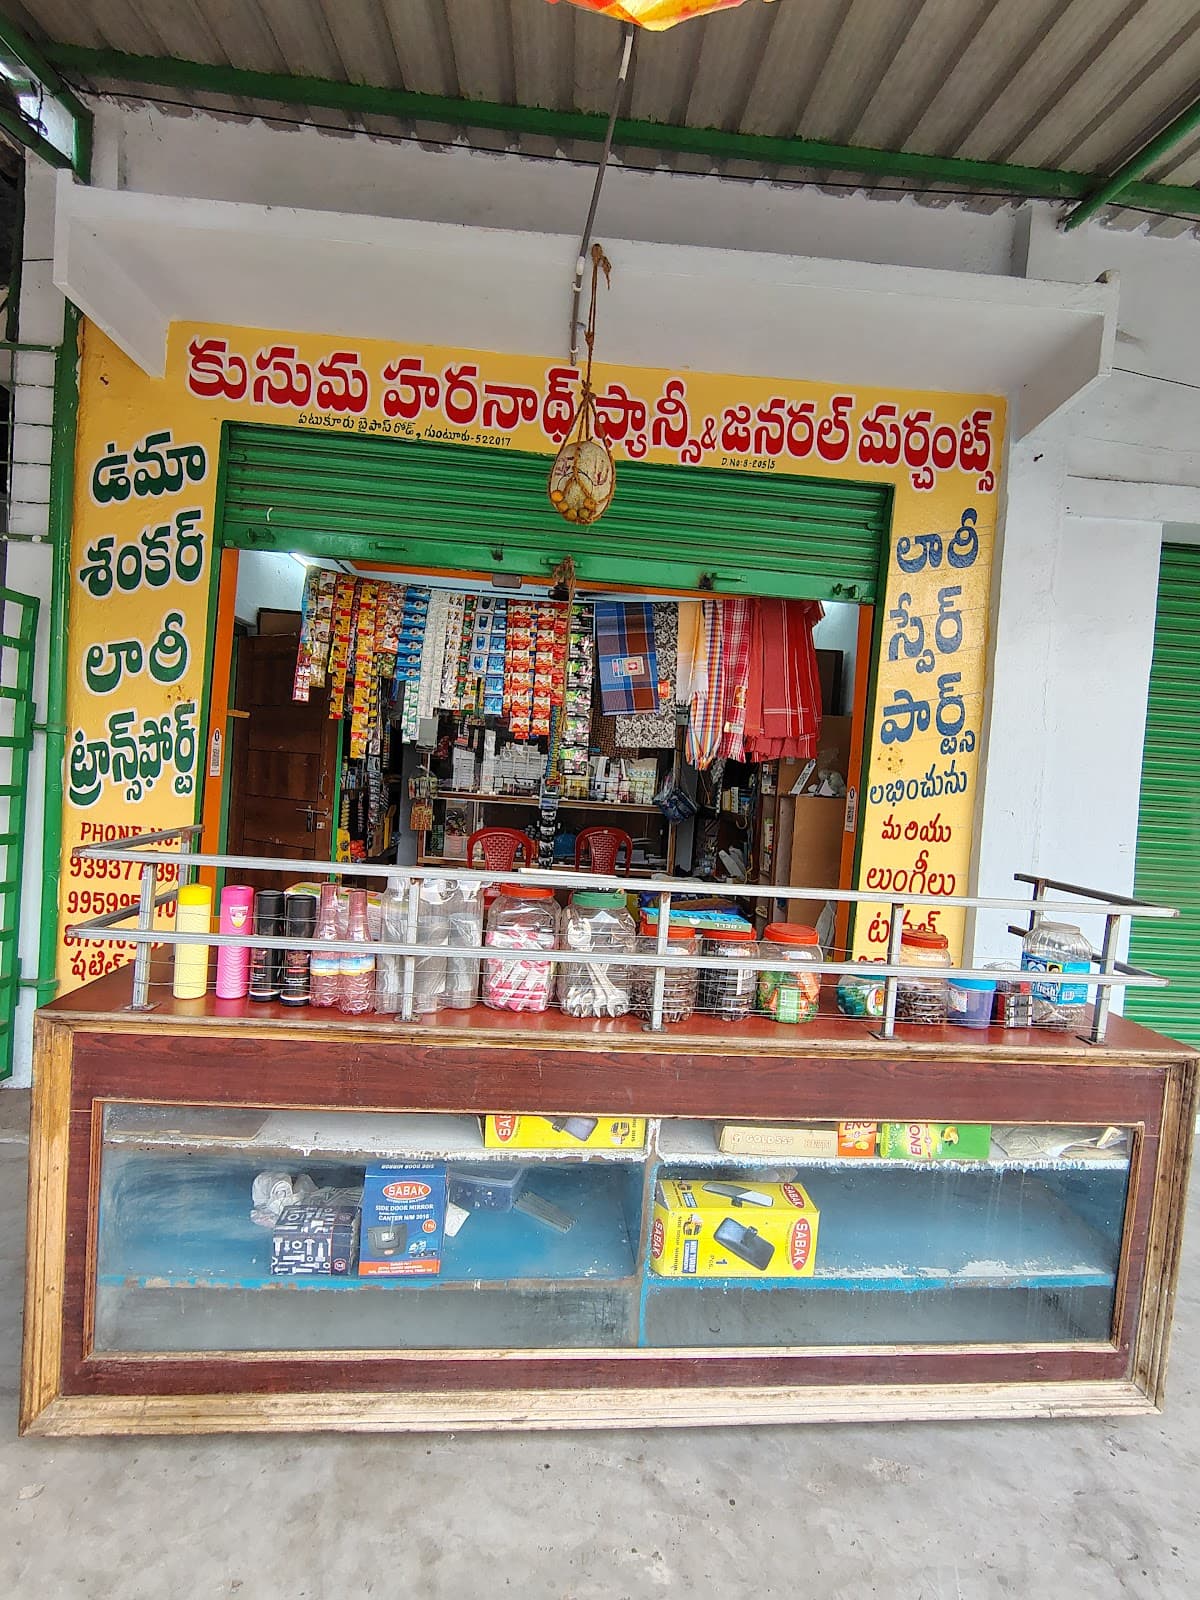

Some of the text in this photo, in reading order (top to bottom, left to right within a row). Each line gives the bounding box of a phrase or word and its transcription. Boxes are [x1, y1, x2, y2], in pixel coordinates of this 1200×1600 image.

[187, 339, 369, 413] కుసుమ
[701, 417, 717, 450] &
[721, 396, 853, 461] జనరల్
[93, 431, 206, 503] ఉమా
[79, 509, 204, 597] శంకర్
[895, 507, 979, 573] లారీ
[86, 612, 188, 693] లారీ
[869, 759, 968, 807] లభించును
[80, 821, 142, 843] PHONE
[881, 813, 952, 843] మరియు
[866, 849, 956, 896] లుంగీలు
[909, 1125, 922, 1155] ENO
[388, 1185, 425, 1197] SABAK
[784, 1183, 804, 1207] SABAK
[651, 1220, 664, 1256] SABAK
[793, 1222, 808, 1266] SABAK
